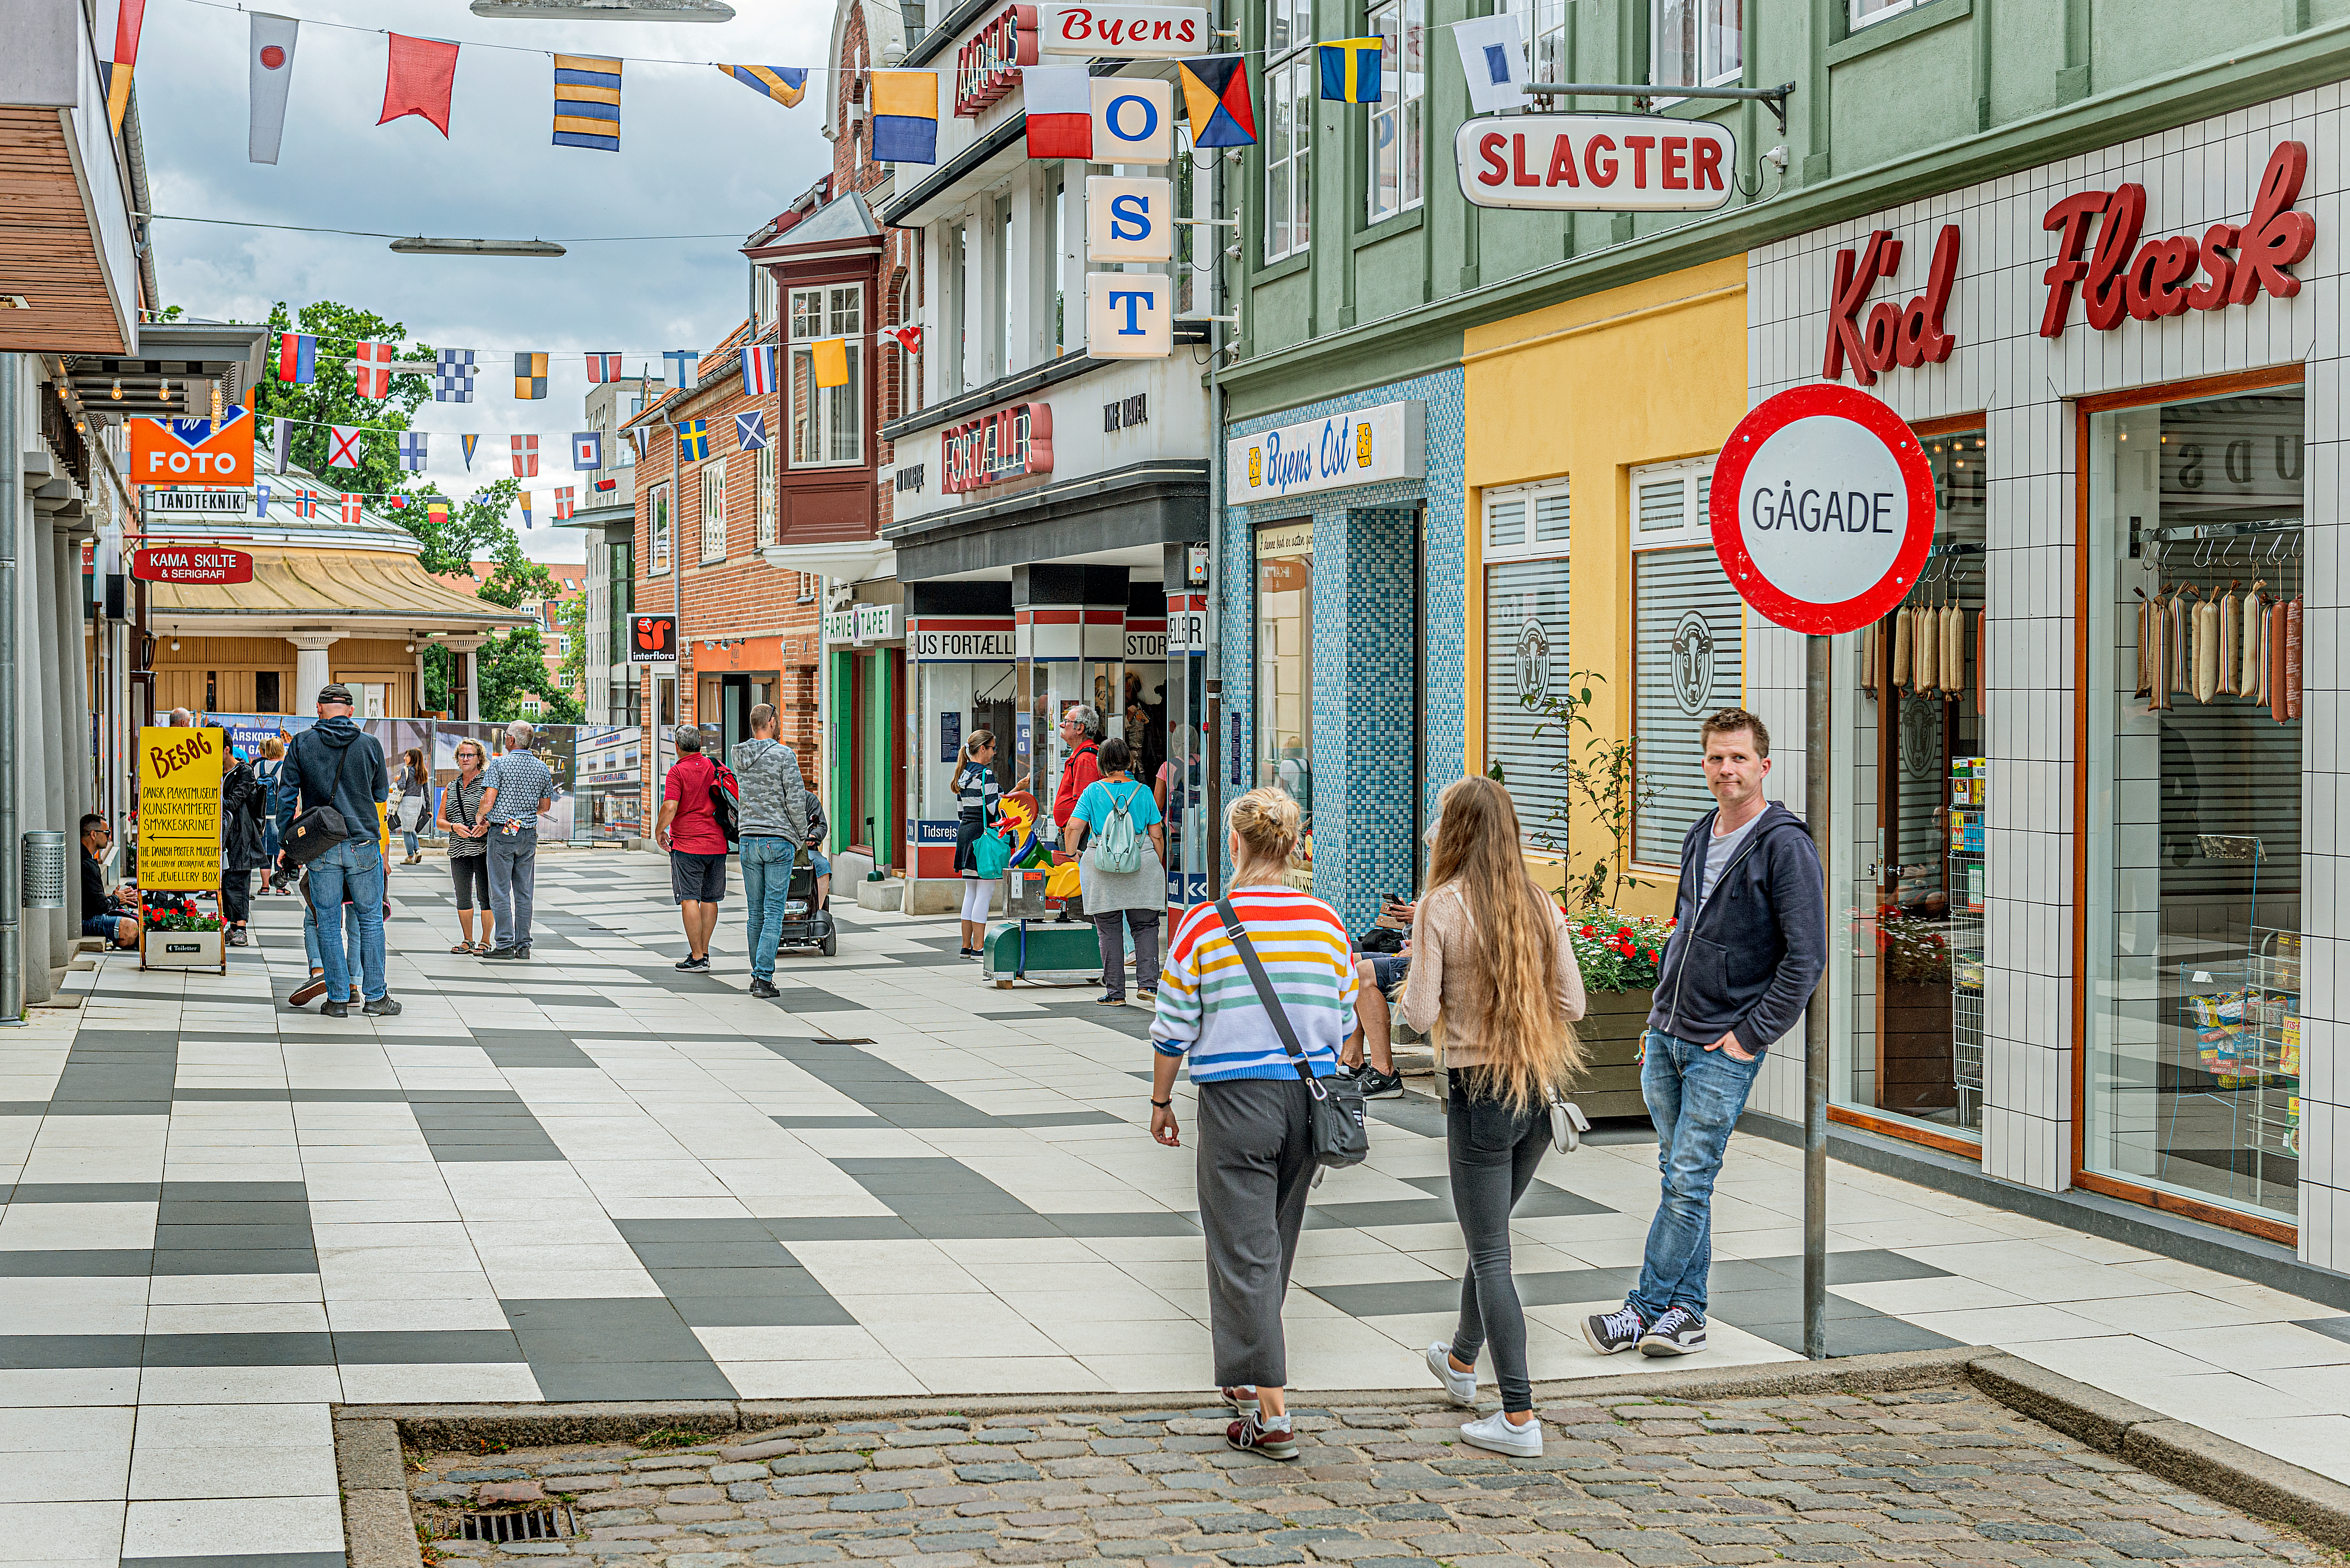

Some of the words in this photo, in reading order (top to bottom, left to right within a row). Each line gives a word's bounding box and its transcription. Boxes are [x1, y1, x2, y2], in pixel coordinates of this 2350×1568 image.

[1057, 8, 1196, 46] Byens
[954, 6, 1031, 118] AARHUS
[1478, 133, 1724, 190] SLAGTER
[2040, 140, 2316, 338] Flæsk
[1121, 393, 1148, 427] TRAVEL
[942, 407, 1044, 493] FORTÆLLER
[1267, 432, 1312, 493] Byens
[1321, 417, 1350, 478] Ost
[150, 452, 236, 474] FOTO
[1753, 480, 1894, 534] GÅGADE
[150, 554, 189, 568] KAMA
[195, 554, 237, 568] SKILTE
[171, 569, 225, 579] SERIGRAFI
[825, 615, 852, 639] FARVE
[861, 610, 889, 635] TAPET
[943, 635, 1016, 654] FORTÆLL
[633, 651, 675, 661] interflora
[595, 734, 620, 746] AARHUS
[150, 732, 212, 779] BESØG
[589, 772, 628, 783] FORTÆLLER
[144, 787, 166, 799] DANSK
[167, 787, 218, 799] PLAKATMUSEUM
[143, 803, 217, 816] KUNSTKAMMERET
[144, 819, 215, 831] SMYKKESKRINET
[140, 846, 150, 857] THE
[152, 846, 172, 857] DANISH
[174, 846, 195, 857] POSTER
[196, 846, 220, 857] MUSEUM
[178, 860, 205, 869] DECORATIVE
[142, 872, 155, 882] THE
[158, 871, 199, 882] JEWELLERY
[202, 871, 218, 882] BOX
